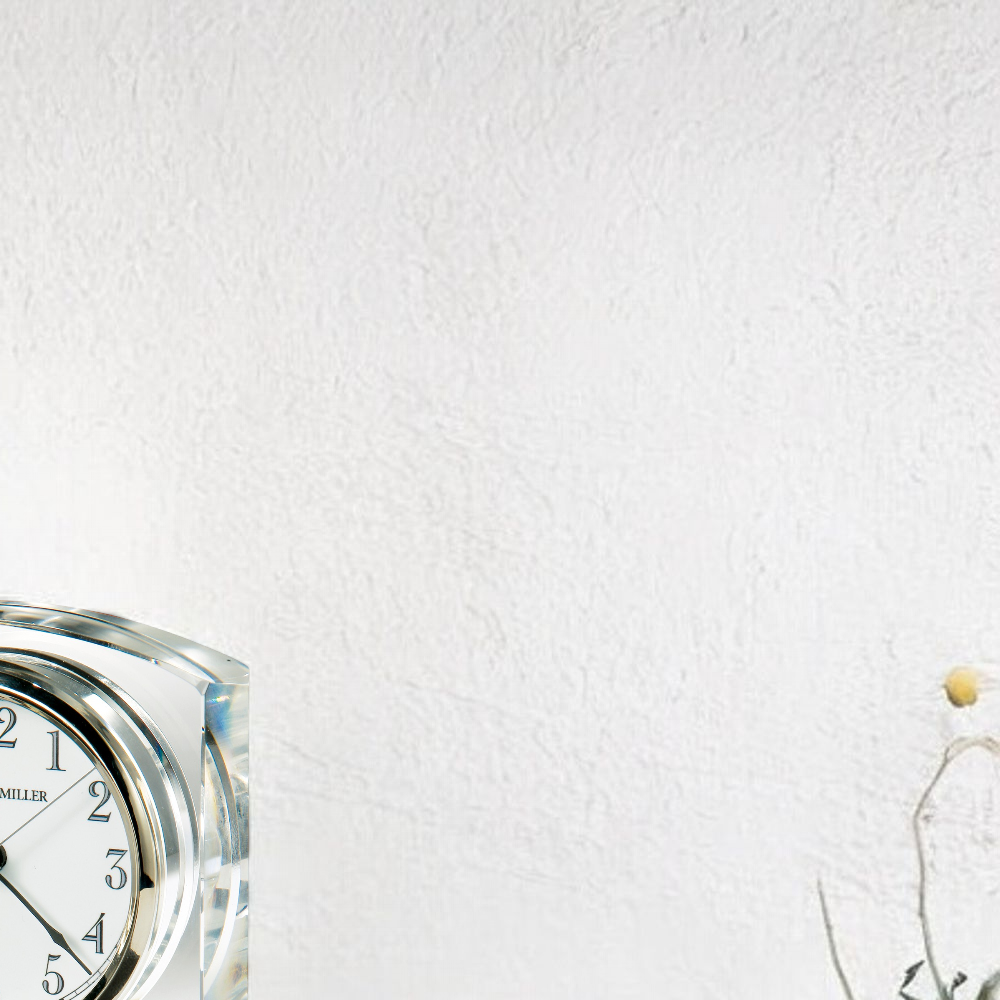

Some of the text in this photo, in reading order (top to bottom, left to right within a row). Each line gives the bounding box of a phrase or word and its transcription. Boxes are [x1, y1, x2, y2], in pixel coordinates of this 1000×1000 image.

[46, 730, 66, 771] 1
[0, 787, 48, 802] MILLER
[88, 780, 112, 822] 2
[105, 849, 128, 890] 3
[82, 913, 104, 954] 4
[42, 954, 65, 995] 5
